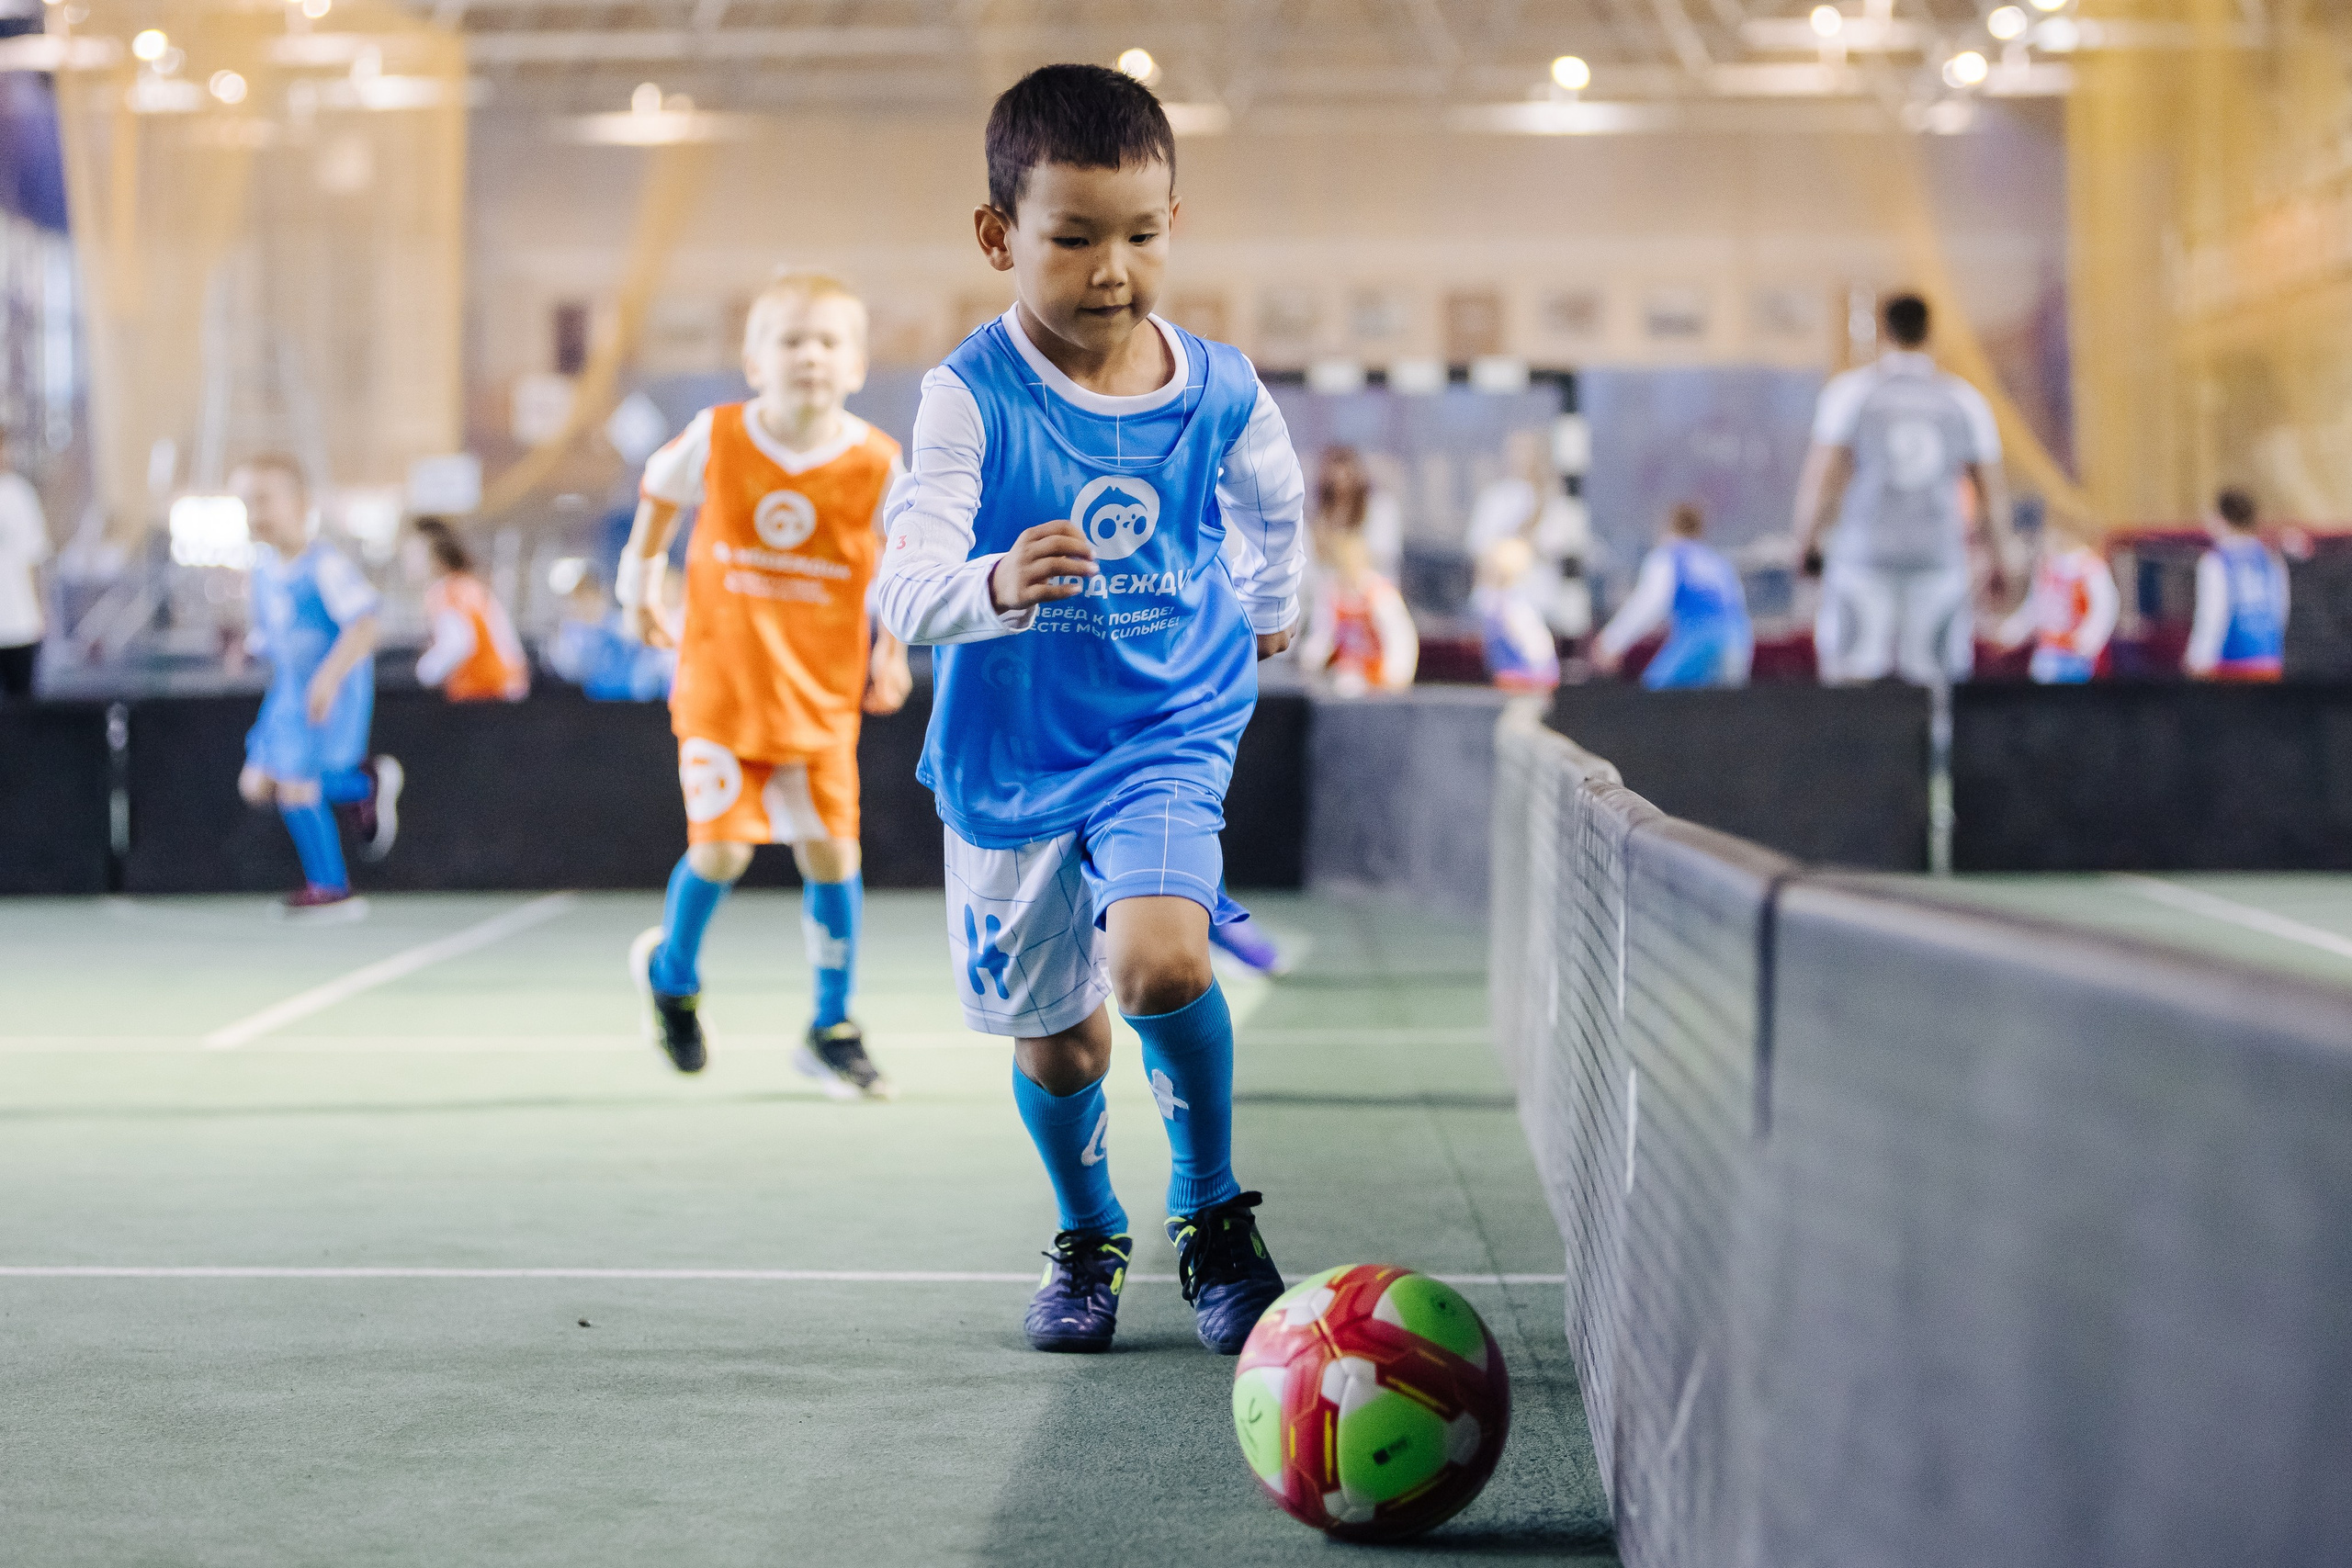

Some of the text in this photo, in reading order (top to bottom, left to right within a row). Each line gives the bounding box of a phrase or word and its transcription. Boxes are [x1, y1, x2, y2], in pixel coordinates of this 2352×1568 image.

[1036, 605, 1175, 626] ЕРЁД К ПОБЕДЕ!
[1076, 623, 1107, 640] МЫ
[1110, 615, 1181, 641] СИЛЬНЕЕ!
